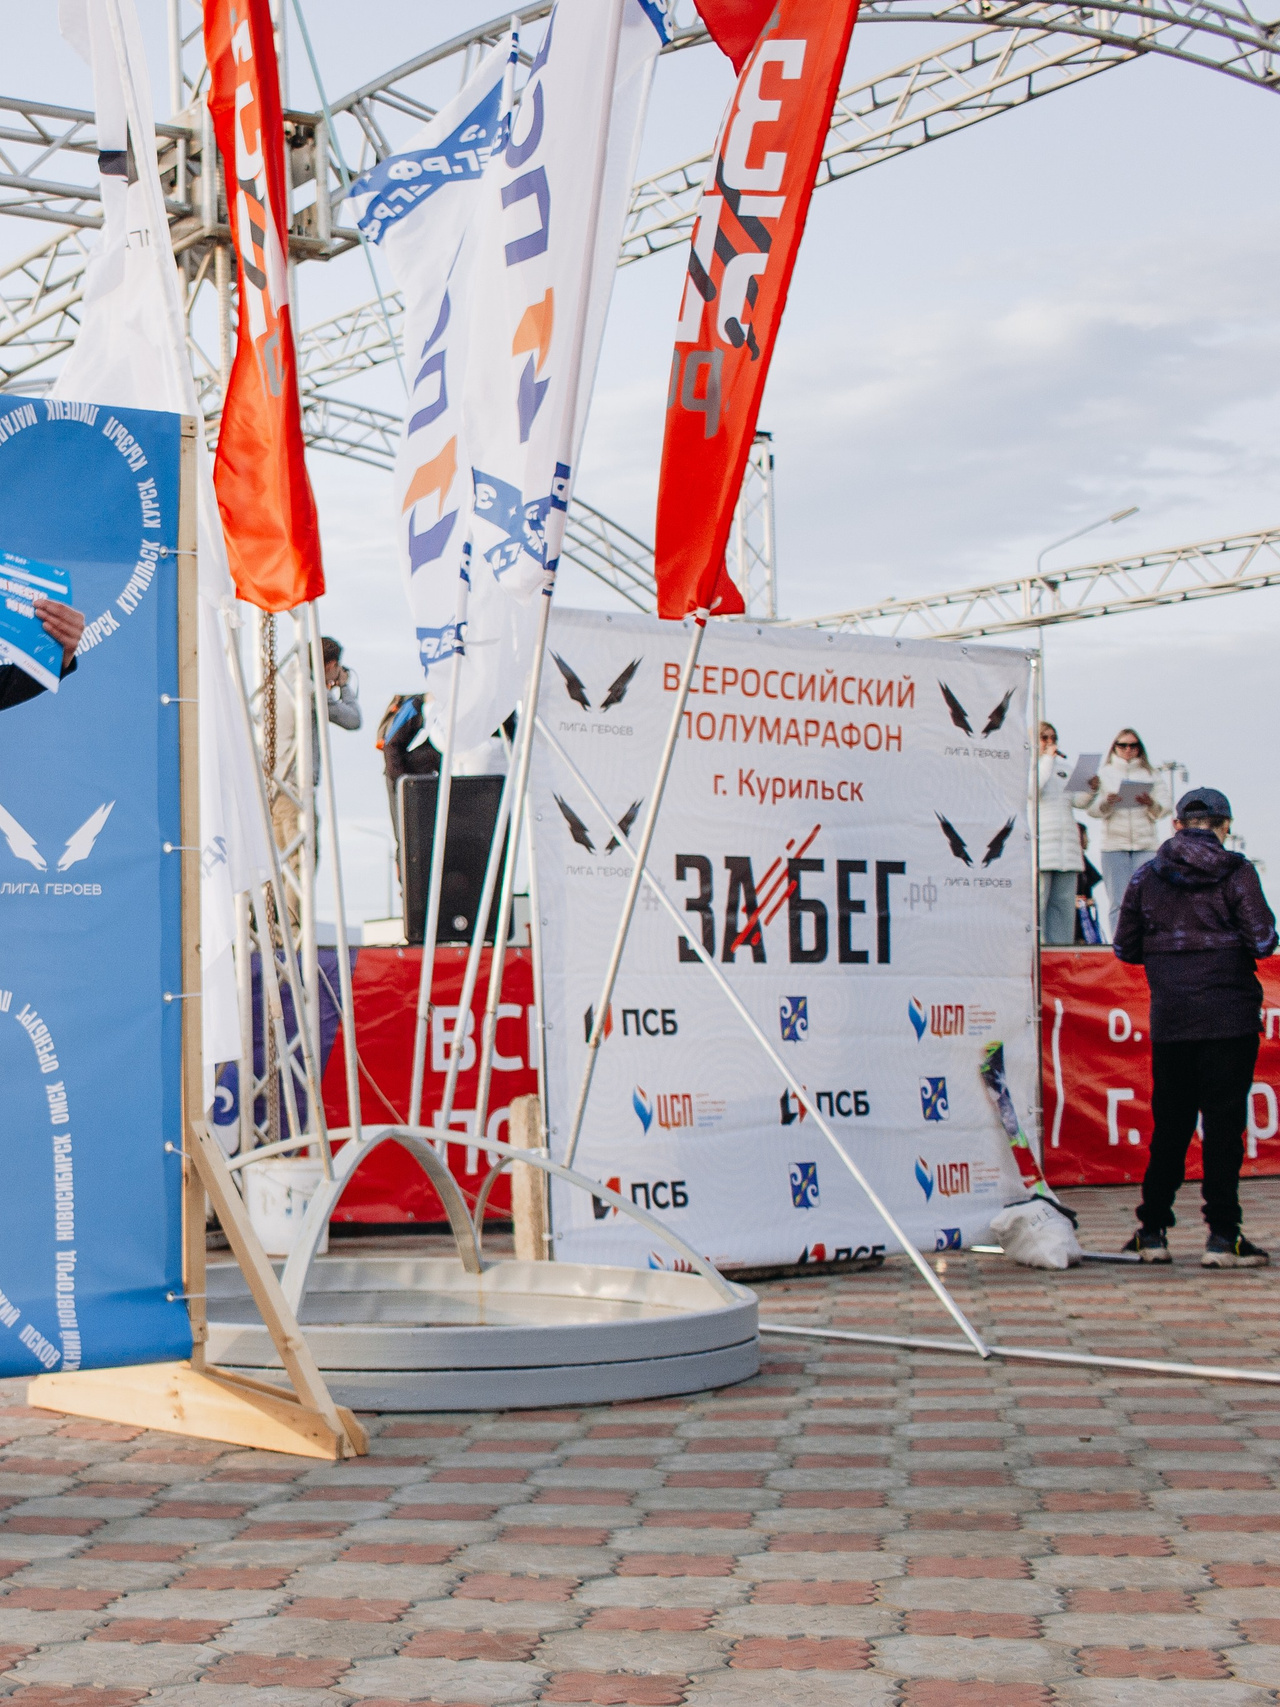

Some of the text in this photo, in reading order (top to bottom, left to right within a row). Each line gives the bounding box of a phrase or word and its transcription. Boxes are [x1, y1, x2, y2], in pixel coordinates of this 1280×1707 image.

[43, 400, 100, 427] ЛИПЕЦК
[101, 415, 148, 473] КЫЗЫЛ
[136, 476, 162, 529] КУРСК
[115, 538, 161, 616] КУРИЛЬСК
[663, 662, 917, 710] ВСЕРОССИЙСКИЙ
[559, 721, 634, 736] ЛИГА ГЕРОЕВ
[677, 710, 904, 753] ПОЛУМАРАФОН
[944, 746, 1010, 760] ЛИГА ГЕРОЕВ
[712, 768, 865, 806] г. Курильск
[0, 882, 103, 896] ЛИГА ГЕРОЕВ
[566, 865, 594, 877] ЛИГА
[944, 877, 1012, 889] ЛИГА ГЕРОЕВ
[14, 1003, 60, 1075] ОРЕНБУРГ
[622, 1007, 679, 1038] ПСБ
[930, 1003, 965, 1038] ЦСП
[45, 1080, 71, 1126] ОМСК
[656, 1093, 694, 1131] ЦСП
[817, 1089, 871, 1118] ПСБ
[53, 1132, 75, 1242] НОВОСИБИРСК
[630, 1179, 689, 1209] ПСБ
[936, 1161, 971, 1197] ЦСП
[54, 1249, 77, 1330] НОВГОРОД
[18, 1322, 63, 1370] ПСКОВ
